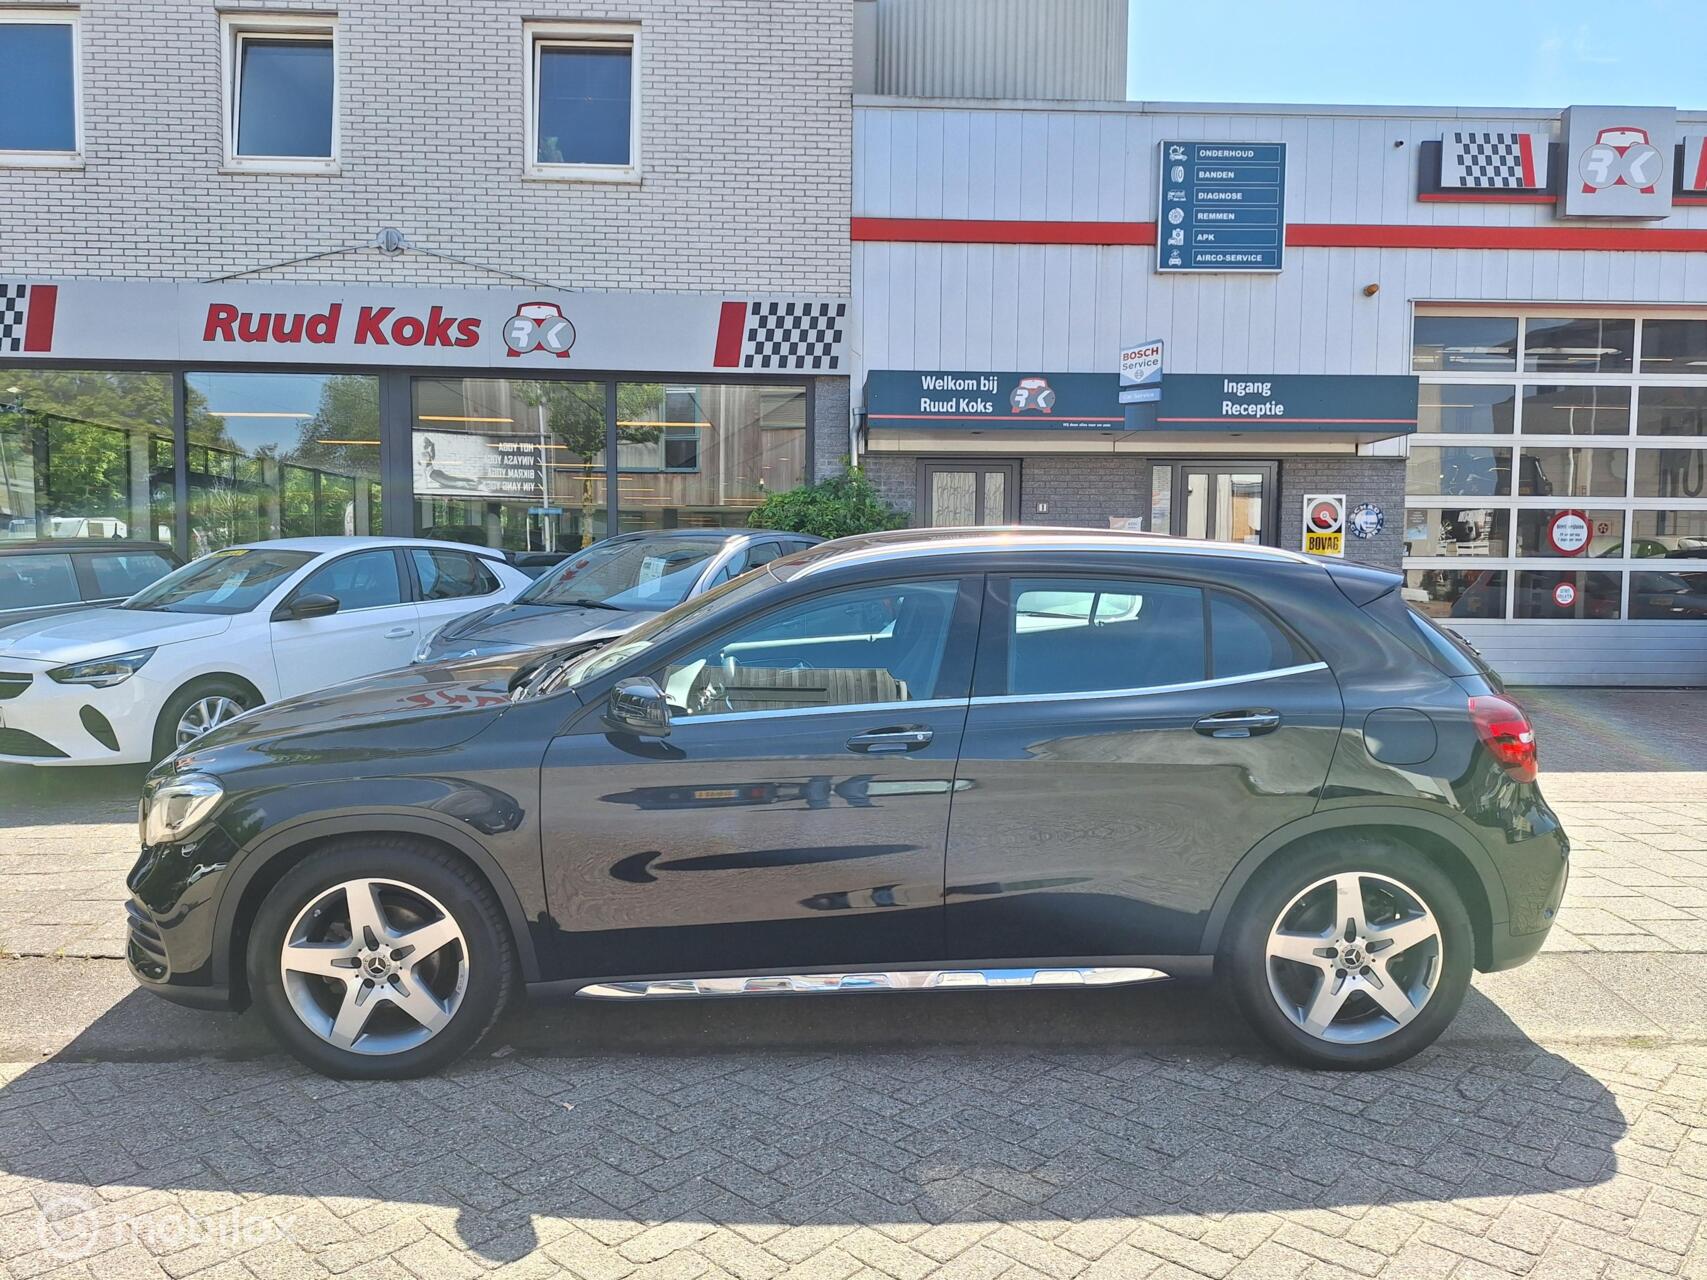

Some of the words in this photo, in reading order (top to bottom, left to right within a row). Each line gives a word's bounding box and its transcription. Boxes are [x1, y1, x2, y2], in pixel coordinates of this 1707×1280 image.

[1199, 149, 1254, 158] ONDERHOUD
[1198, 171, 1235, 179] BANDEN
[1198, 192, 1243, 200] DIAGNOSE
[1197, 212, 1235, 220] REMMEN
[1196, 233, 1215, 241] APK
[1196, 254, 1263, 262] AIRCO-SERVICE
[203, 302, 342, 344] Ruud
[354, 305, 482, 348] Koks
[1122, 346, 1159, 361] BOSCH
[1122, 358, 1159, 371] Service
[921, 375, 977, 391] Welkom
[980, 375, 998, 394] bij
[1223, 378, 1272, 397] Ingang
[920, 397, 956, 413] Ruud
[959, 398, 993, 413] Koks
[1222, 400, 1284, 418] Receptie
[1308, 536, 1339, 551] BOVAG
